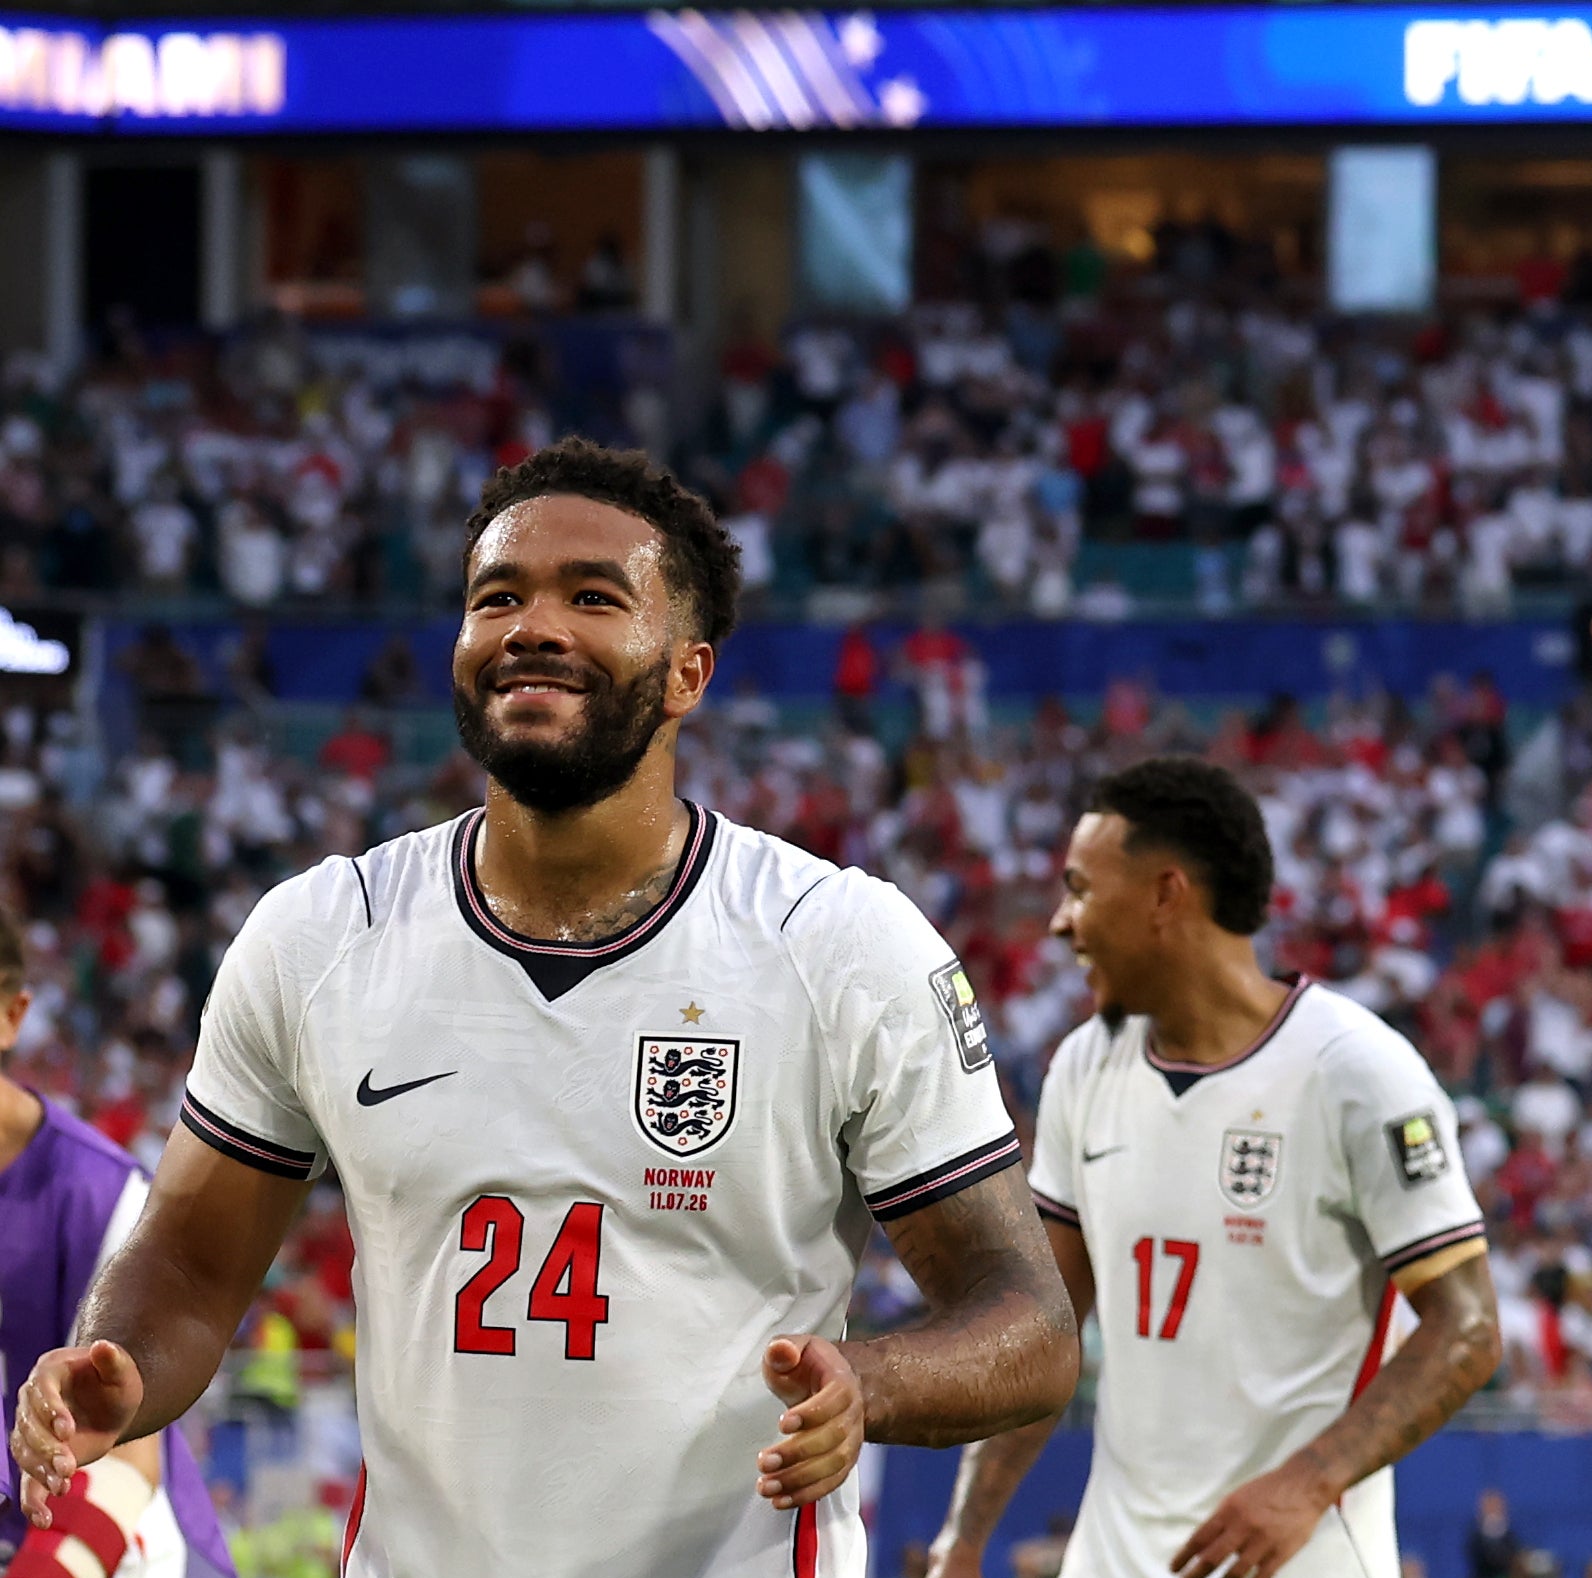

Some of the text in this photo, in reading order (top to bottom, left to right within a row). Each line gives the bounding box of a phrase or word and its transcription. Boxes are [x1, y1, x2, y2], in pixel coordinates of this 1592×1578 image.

[643, 1167, 717, 1189] NORWAY
[649, 1191, 709, 1213] 11.07.26
[454, 1195, 609, 1361] 24
[1132, 1236, 1200, 1341] 17
